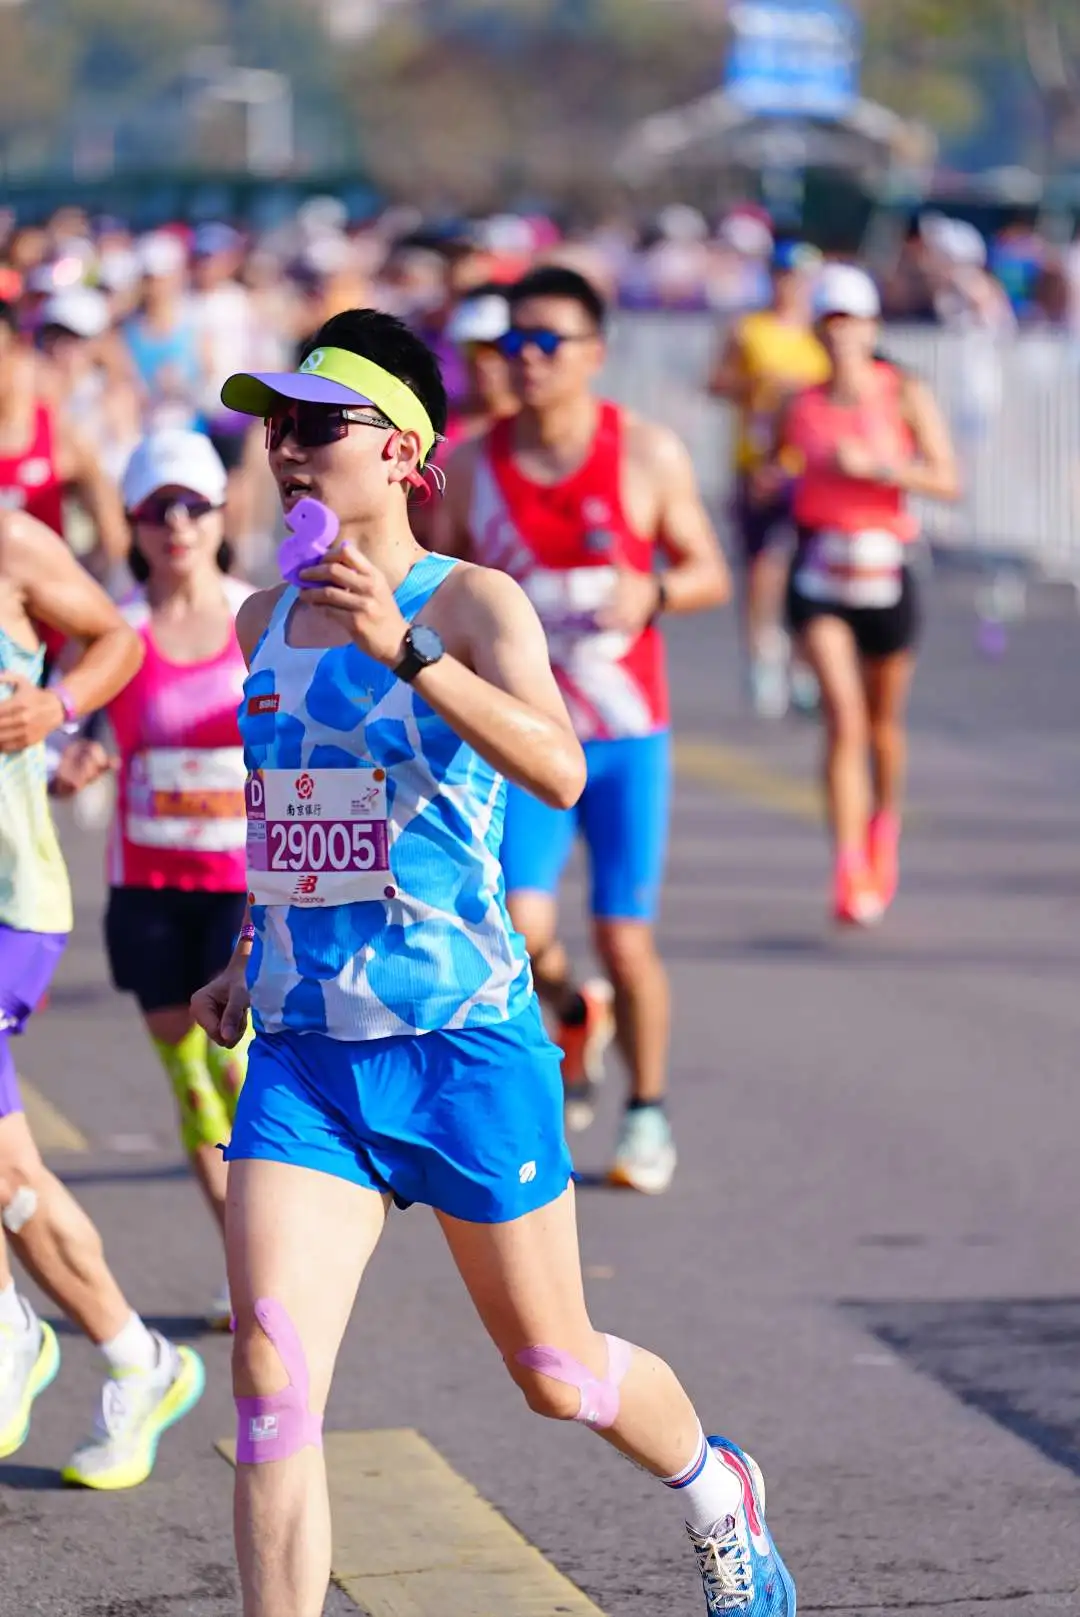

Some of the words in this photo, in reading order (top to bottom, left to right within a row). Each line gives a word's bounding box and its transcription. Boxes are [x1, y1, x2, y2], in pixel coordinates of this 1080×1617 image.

[251, 779, 263, 807] D
[286, 803, 322, 817] 南京银行
[270, 823, 376, 870] 29005
[252, 1415, 277, 1432] LP
